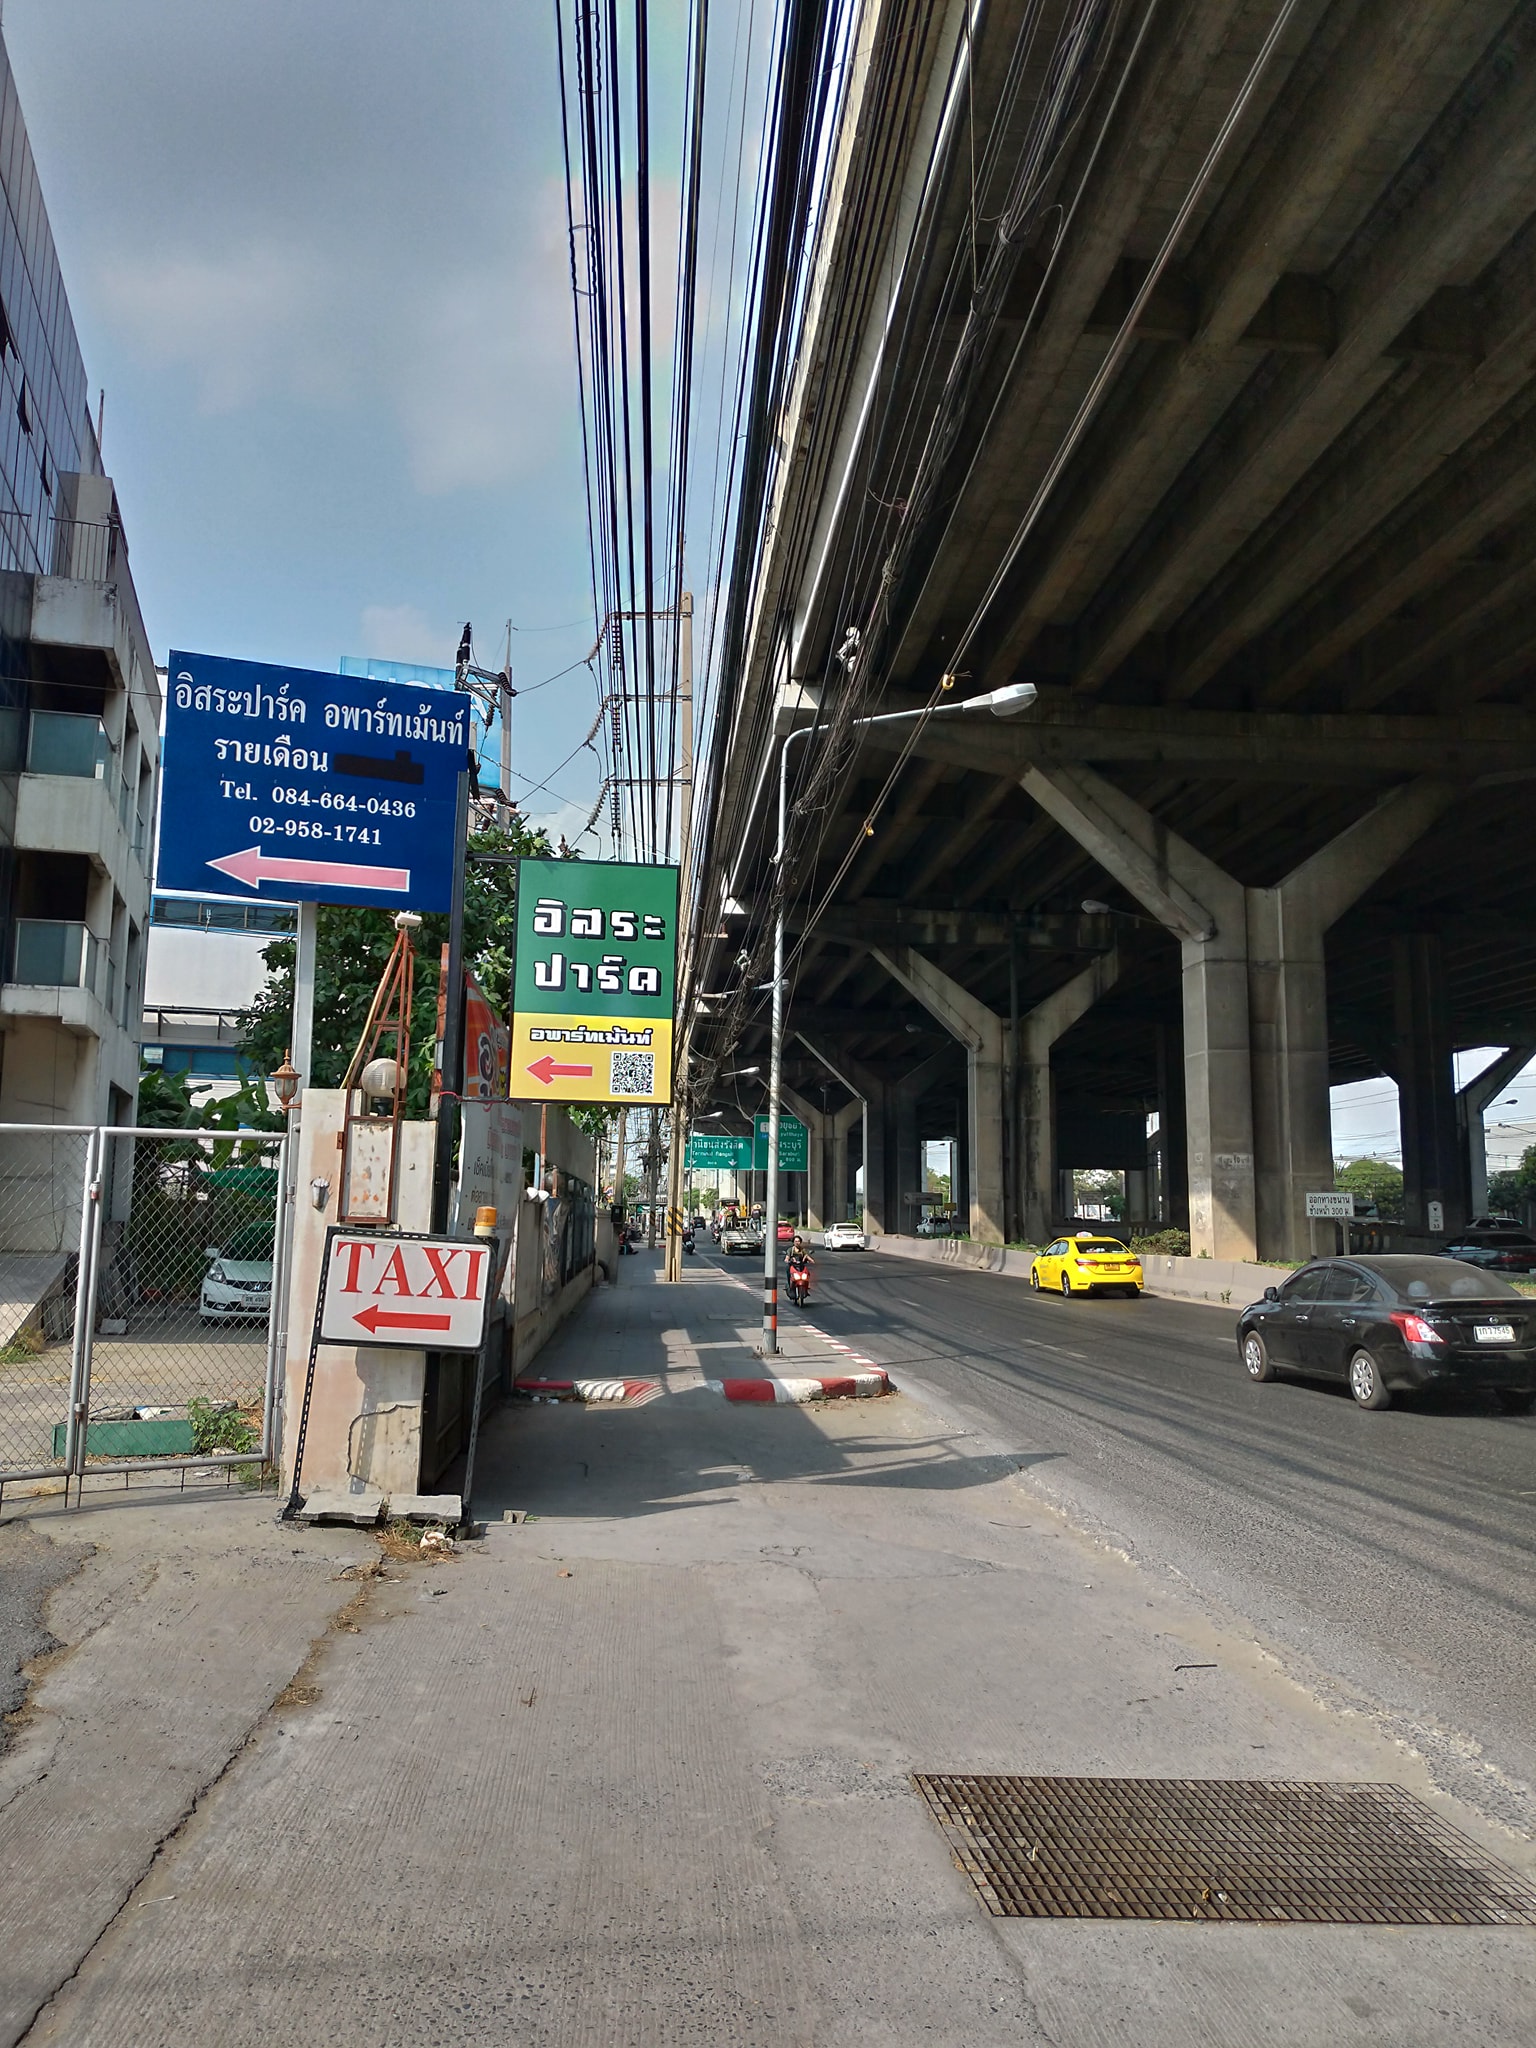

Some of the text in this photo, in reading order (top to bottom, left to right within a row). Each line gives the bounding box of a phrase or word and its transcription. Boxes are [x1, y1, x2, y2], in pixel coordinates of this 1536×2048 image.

[175, 671, 307, 724] อิสระปาร์ค
[324, 697, 464, 745] อพาร์ทเม้นท์
[214, 734, 328, 773] รายเดือน
[219, 779, 416, 819] Tel. 084-664-0436
[249, 815, 382, 846] 02-958-1741
[532, 898, 666, 941] อิสระ
[533, 953, 663, 997] ปาร์ค
[336, 1242, 487, 1300] TAXI
